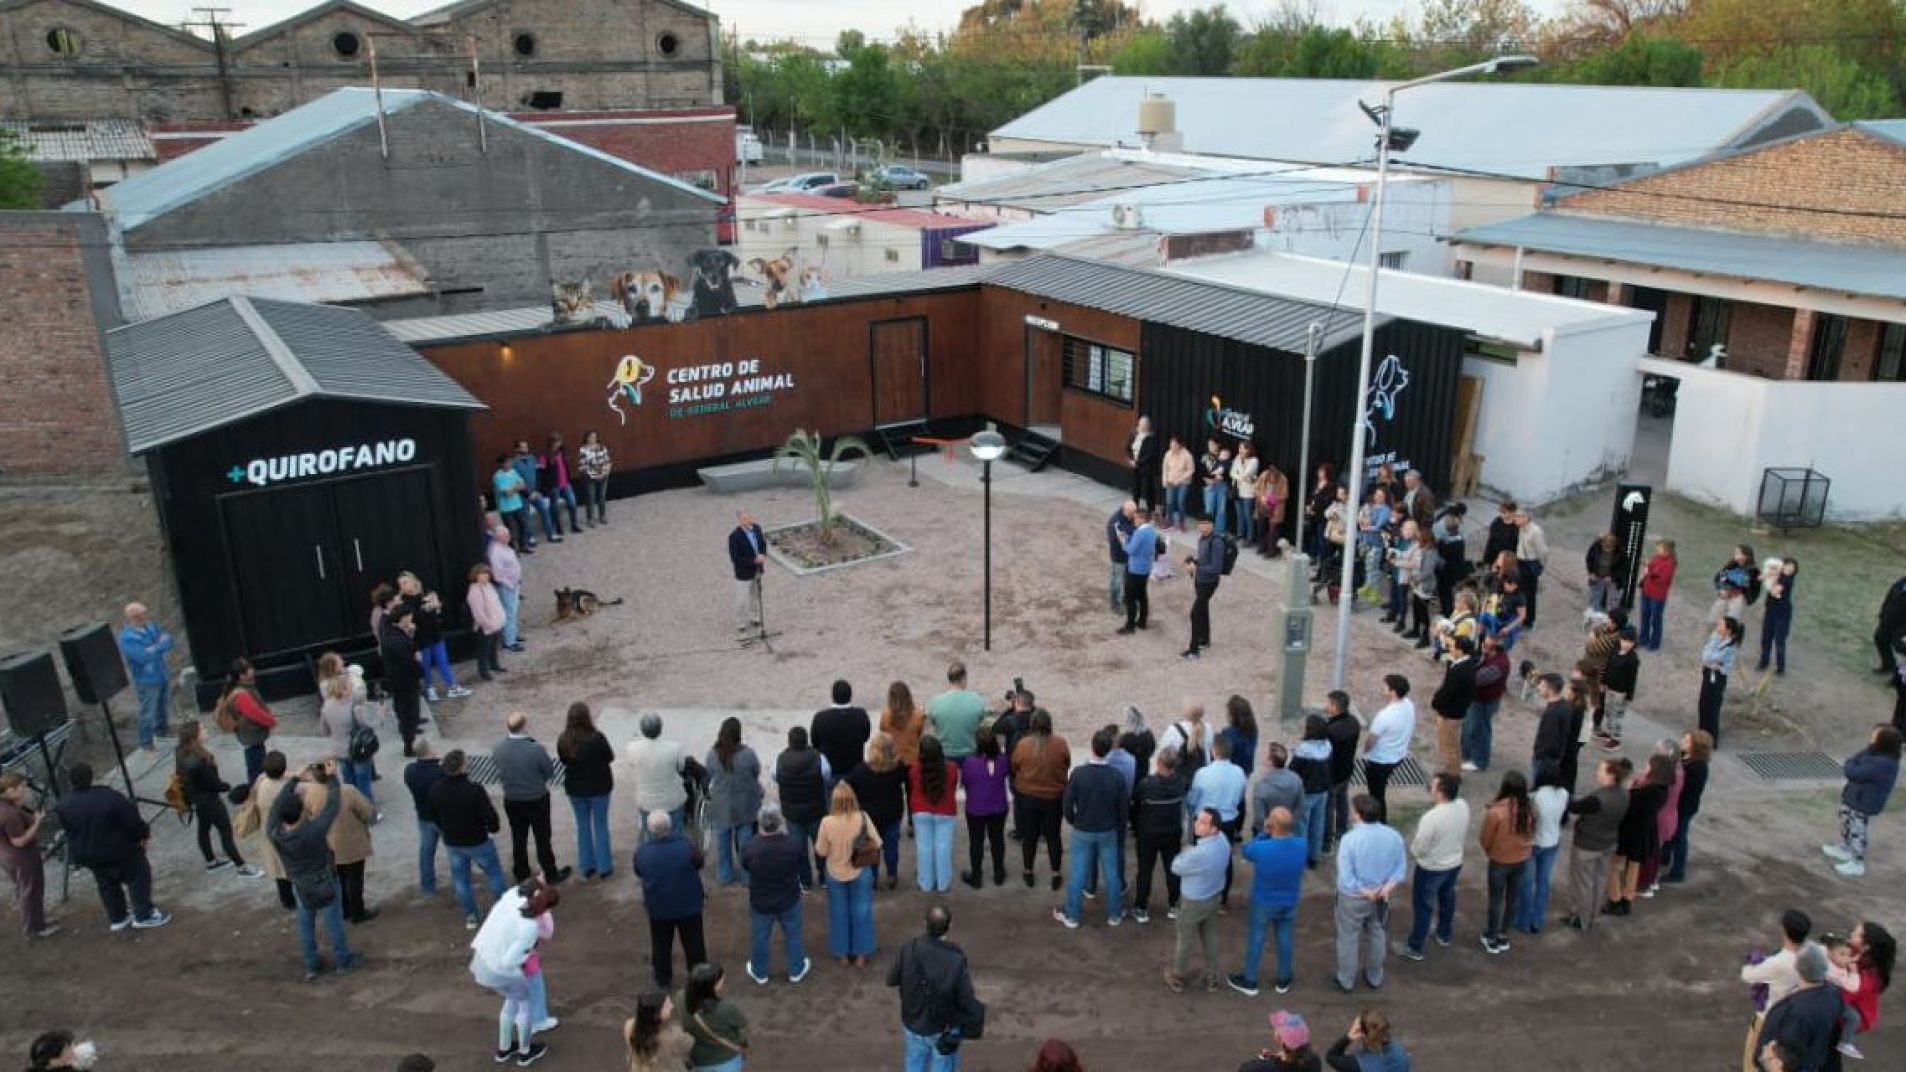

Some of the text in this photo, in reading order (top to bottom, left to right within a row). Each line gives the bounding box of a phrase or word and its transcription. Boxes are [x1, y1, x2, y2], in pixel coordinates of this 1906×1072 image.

[667, 359, 760, 384] CENTRO DE
[669, 373, 794, 404] SALUD ANIMAL
